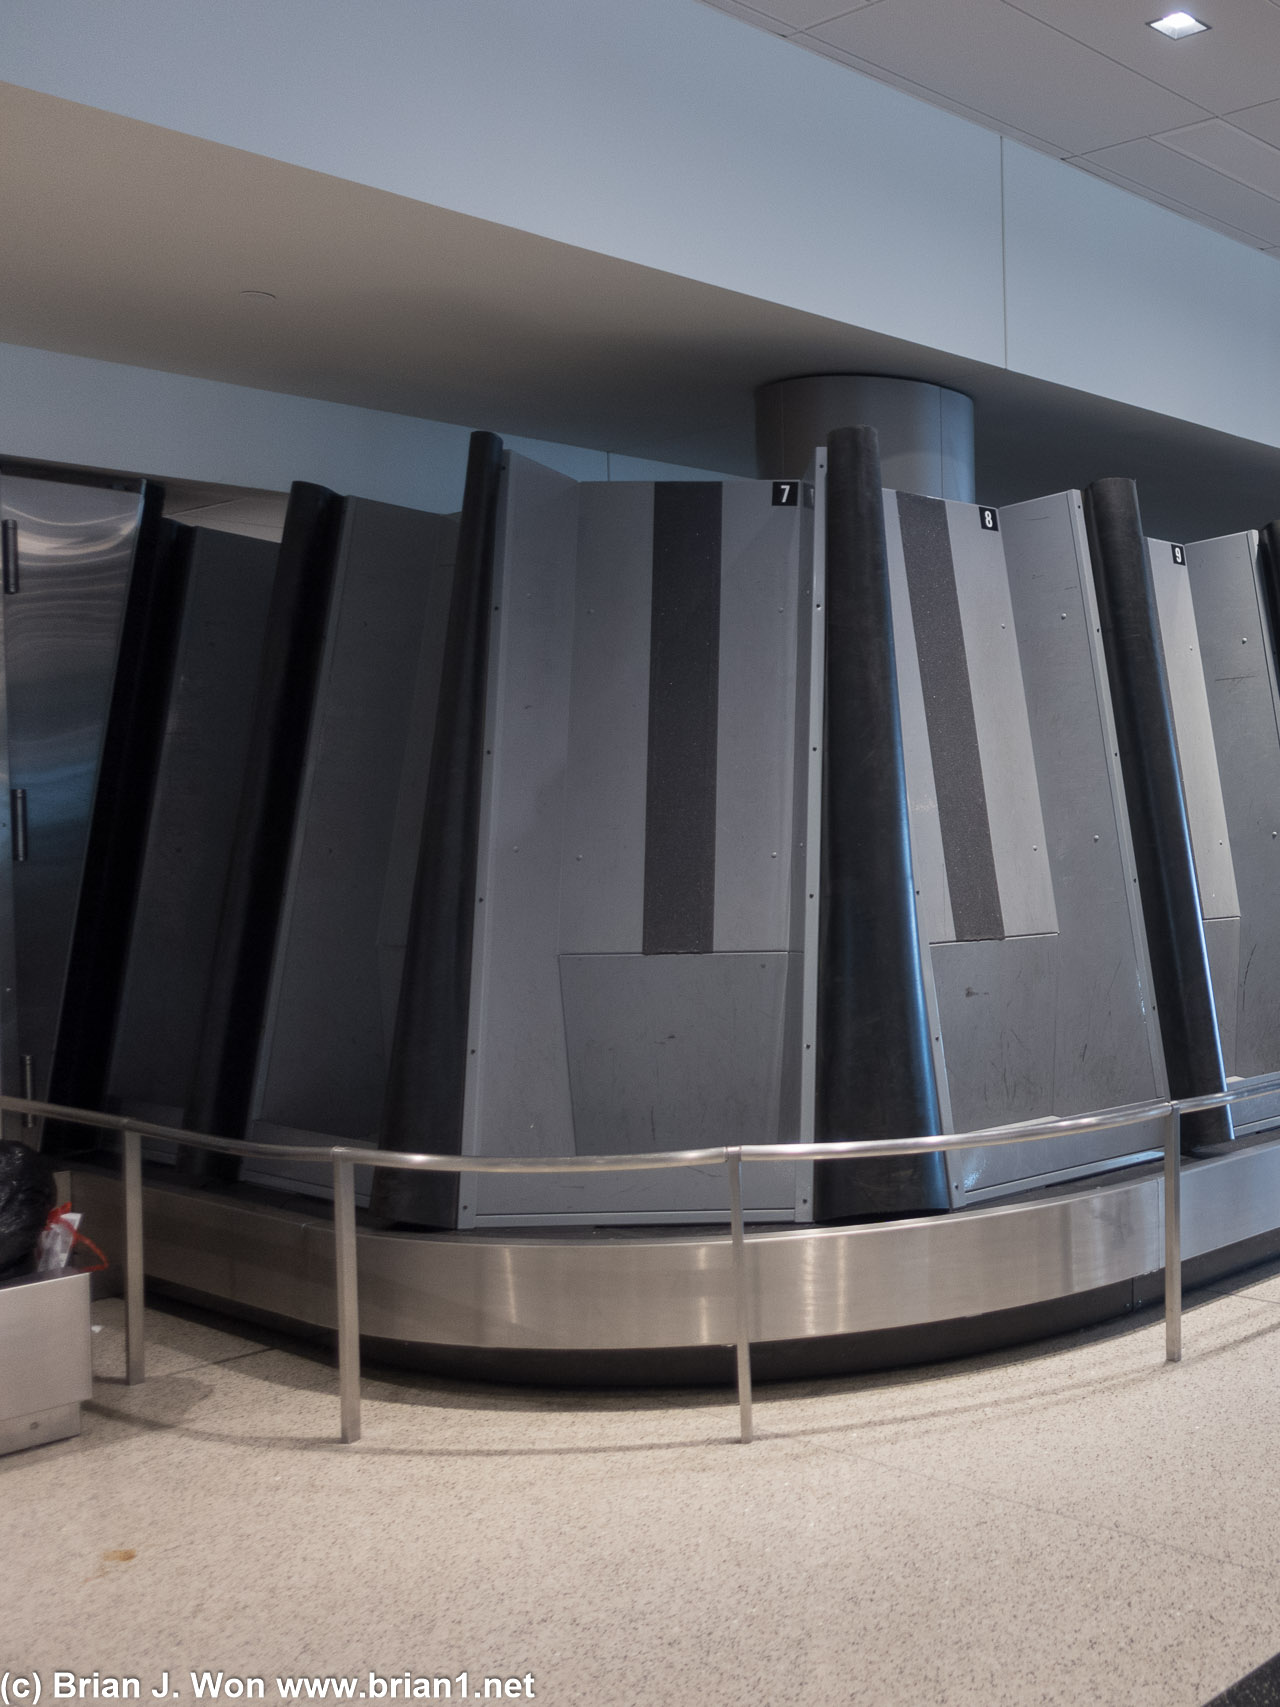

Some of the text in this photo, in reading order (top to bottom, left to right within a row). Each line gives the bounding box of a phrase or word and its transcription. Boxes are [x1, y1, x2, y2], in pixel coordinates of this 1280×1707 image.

[780, 485, 790, 503] 7
[984, 510, 993, 528] 8
[1175, 547, 1182, 563] 9
